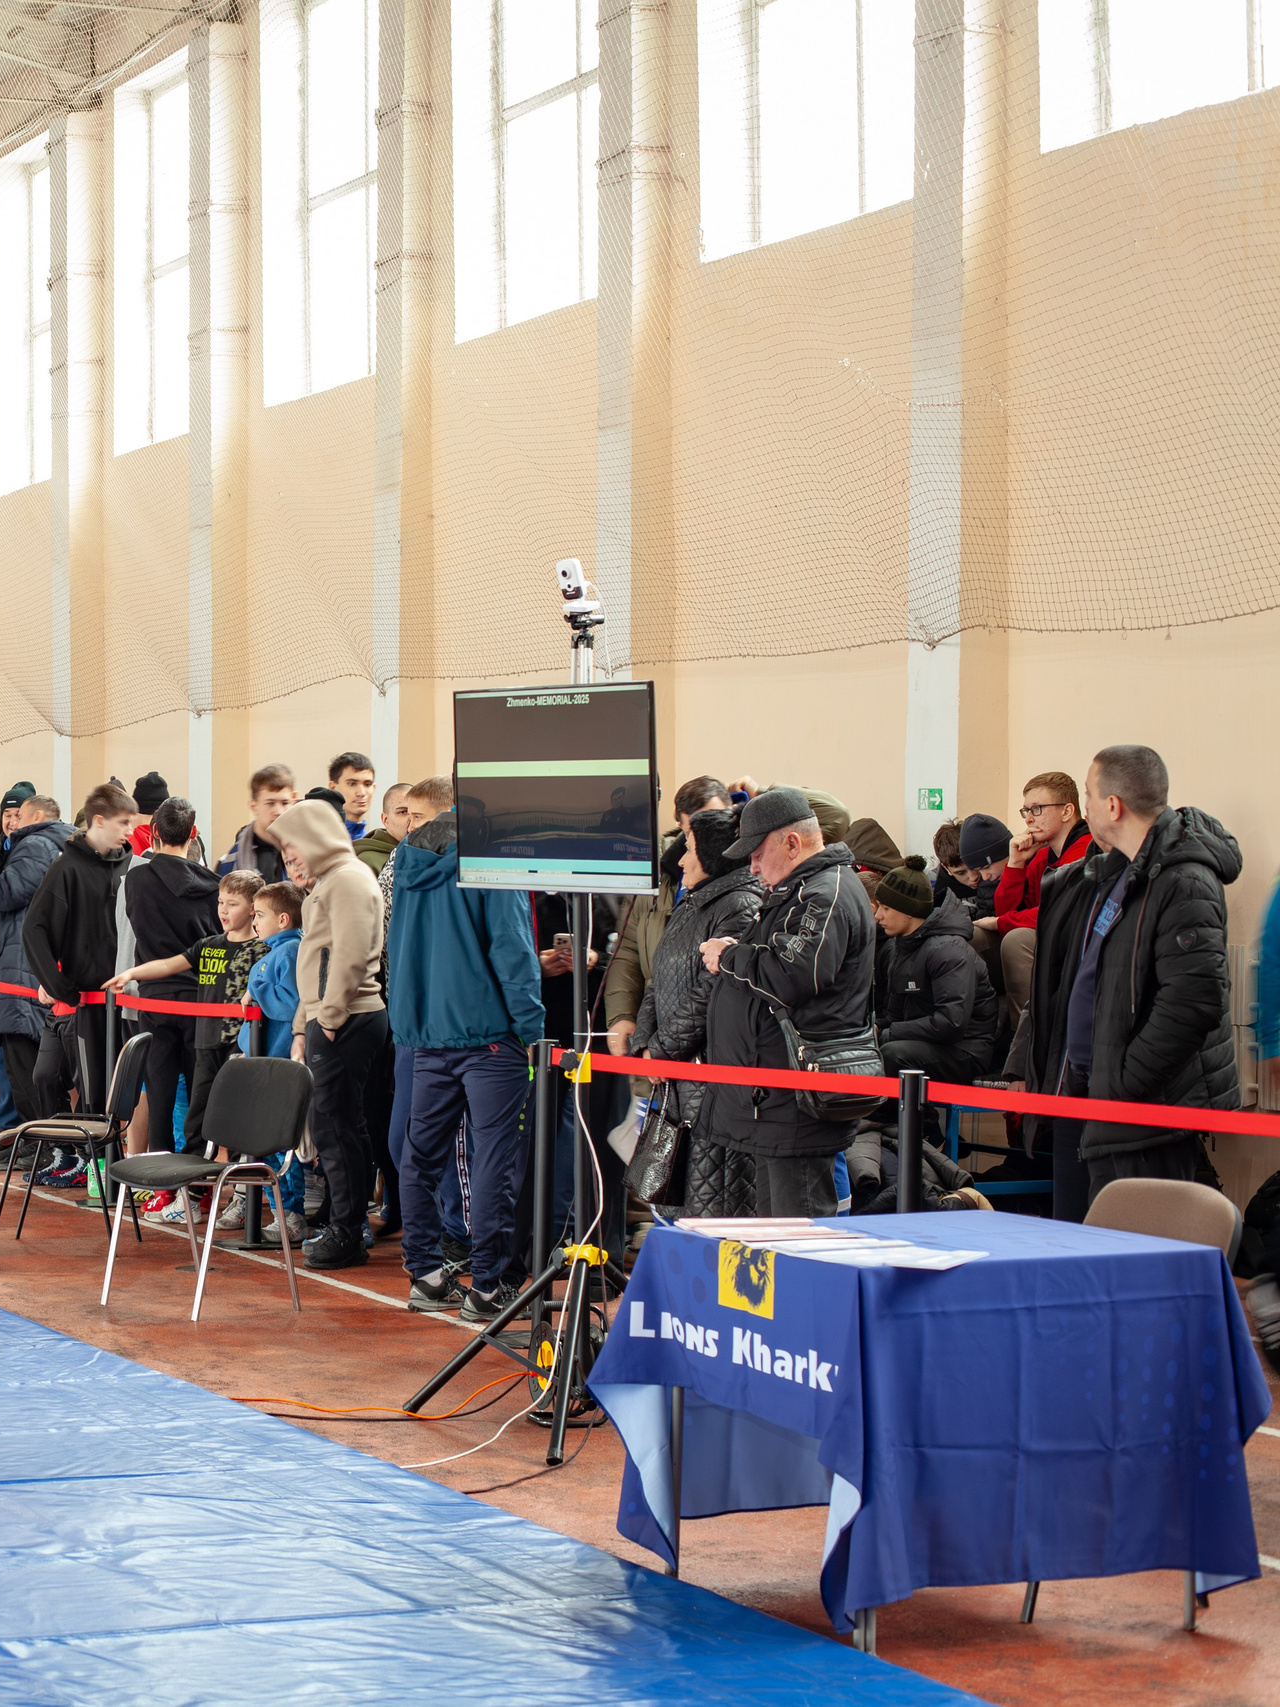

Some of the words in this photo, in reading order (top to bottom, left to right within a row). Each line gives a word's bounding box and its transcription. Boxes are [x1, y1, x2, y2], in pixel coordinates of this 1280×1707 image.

[506, 694, 590, 707] Zhmenko-MEMORIAL-2025
[780, 902, 821, 962] LEGEA
[732, 1326, 839, 1392] Khark
